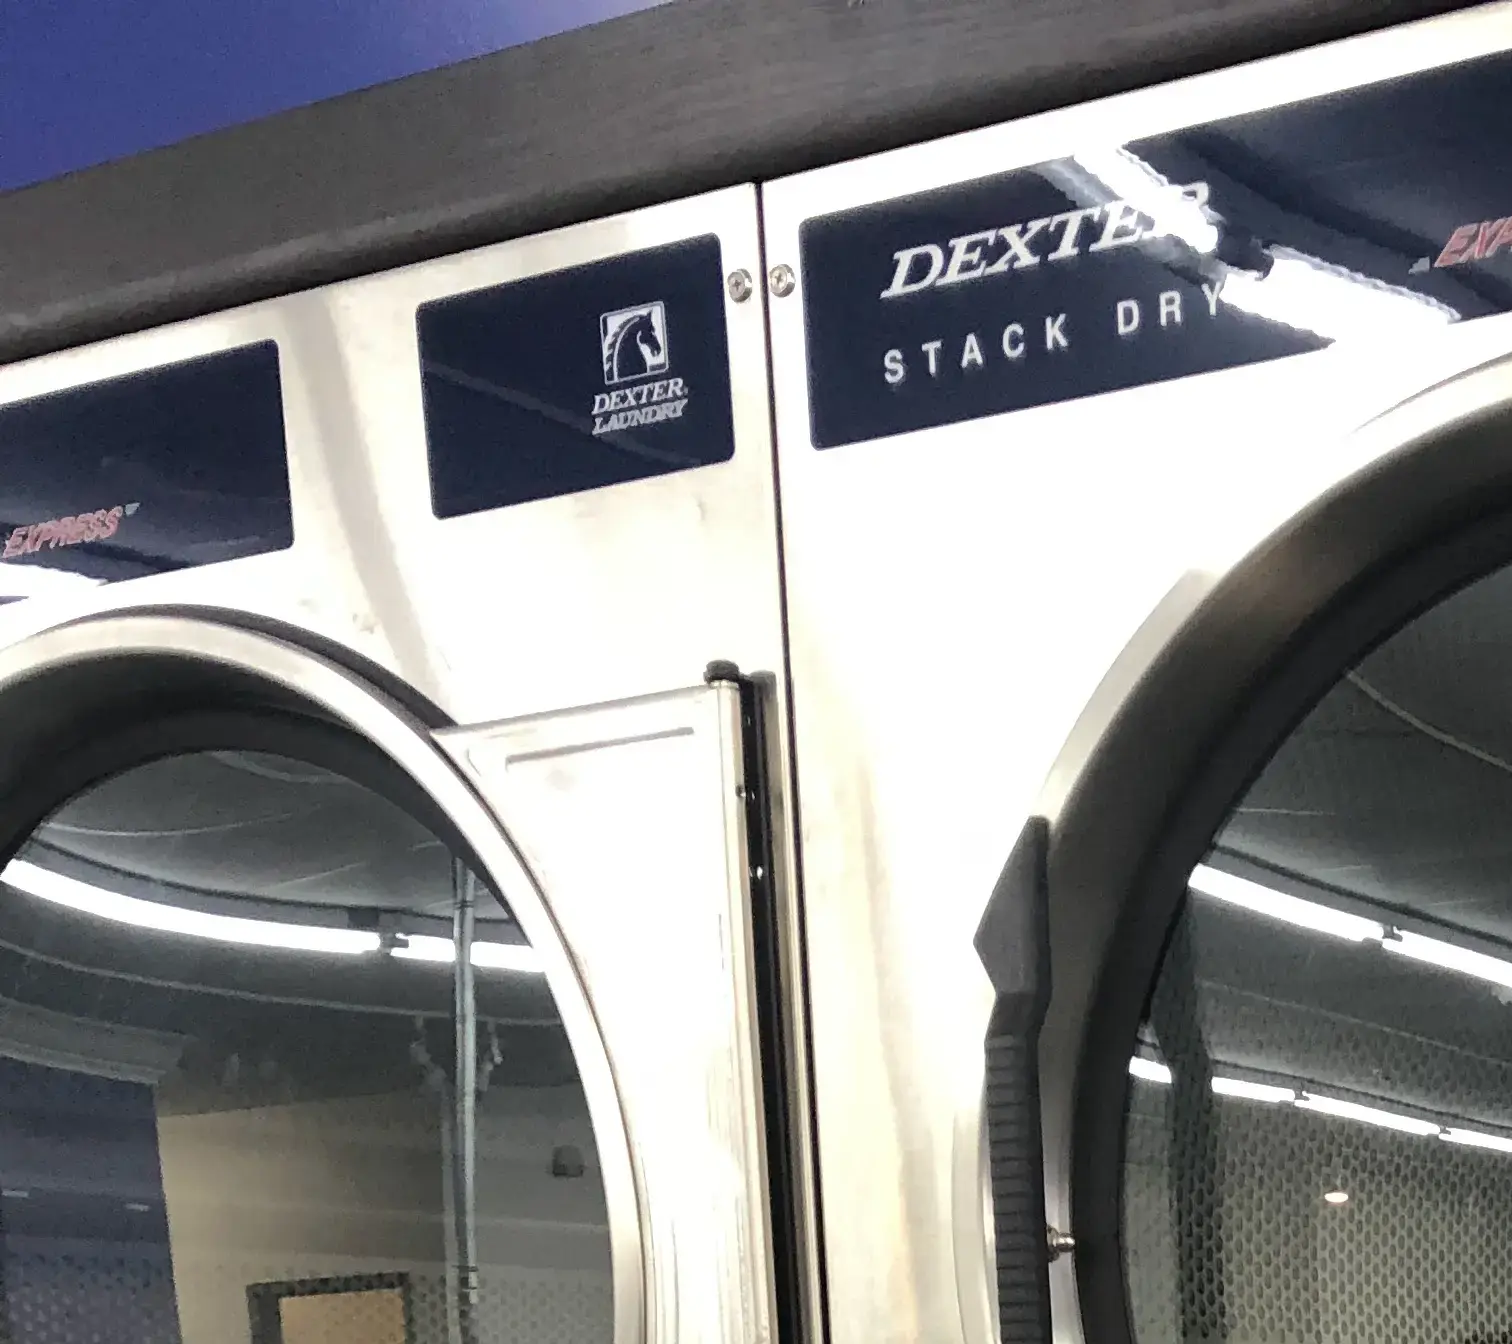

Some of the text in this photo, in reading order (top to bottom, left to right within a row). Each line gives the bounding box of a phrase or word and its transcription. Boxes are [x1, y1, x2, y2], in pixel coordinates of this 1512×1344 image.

[881, 181, 1212, 299] DEXTE
[883, 313, 1069, 384] STACK
[591, 377, 685, 416] DEXTER
[591, 398, 689, 436] LAUNDRY
